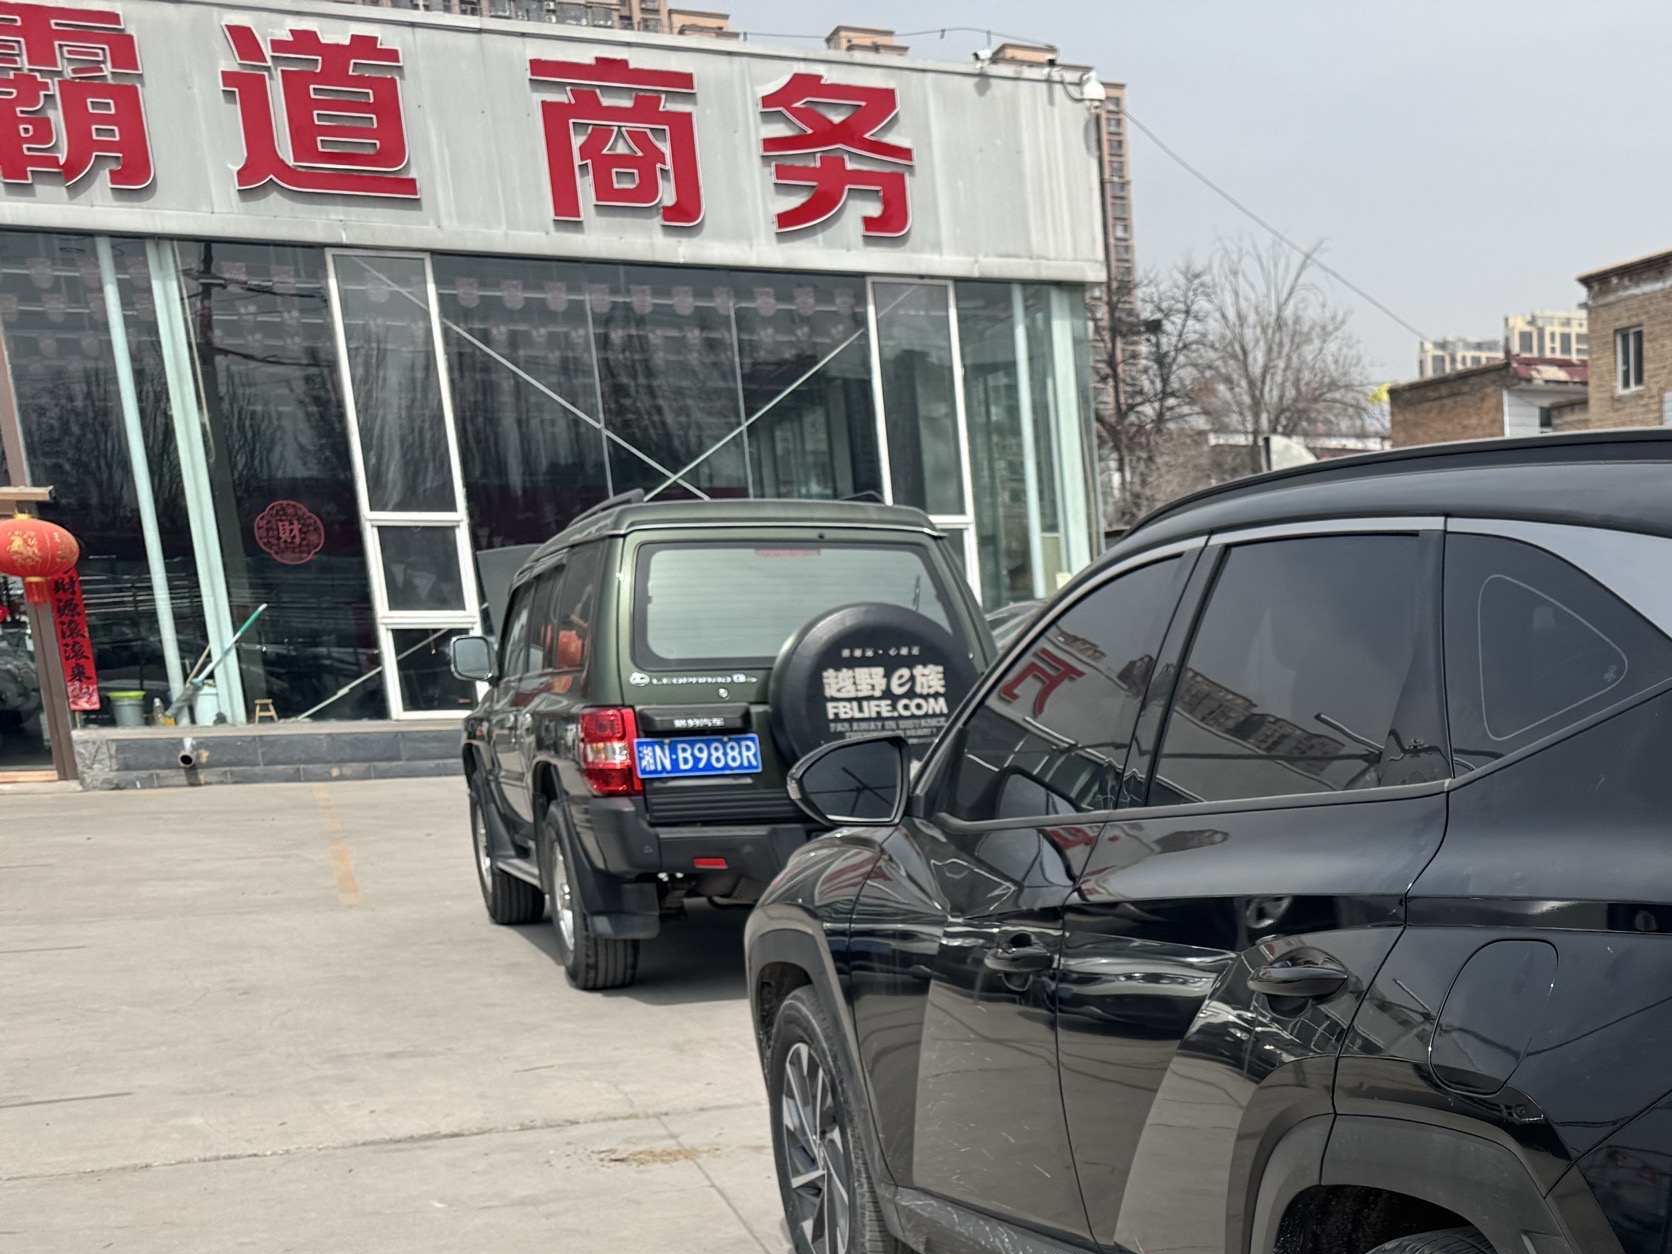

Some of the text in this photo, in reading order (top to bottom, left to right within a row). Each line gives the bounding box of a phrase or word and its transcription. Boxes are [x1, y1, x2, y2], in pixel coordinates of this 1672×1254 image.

[0, 2, 914, 238] 霸道商务
[53, 568, 93, 683] 财源滚滚来
[822, 664, 947, 699] 越野e族
[826, 697, 949, 720] FBLIFE.COM
